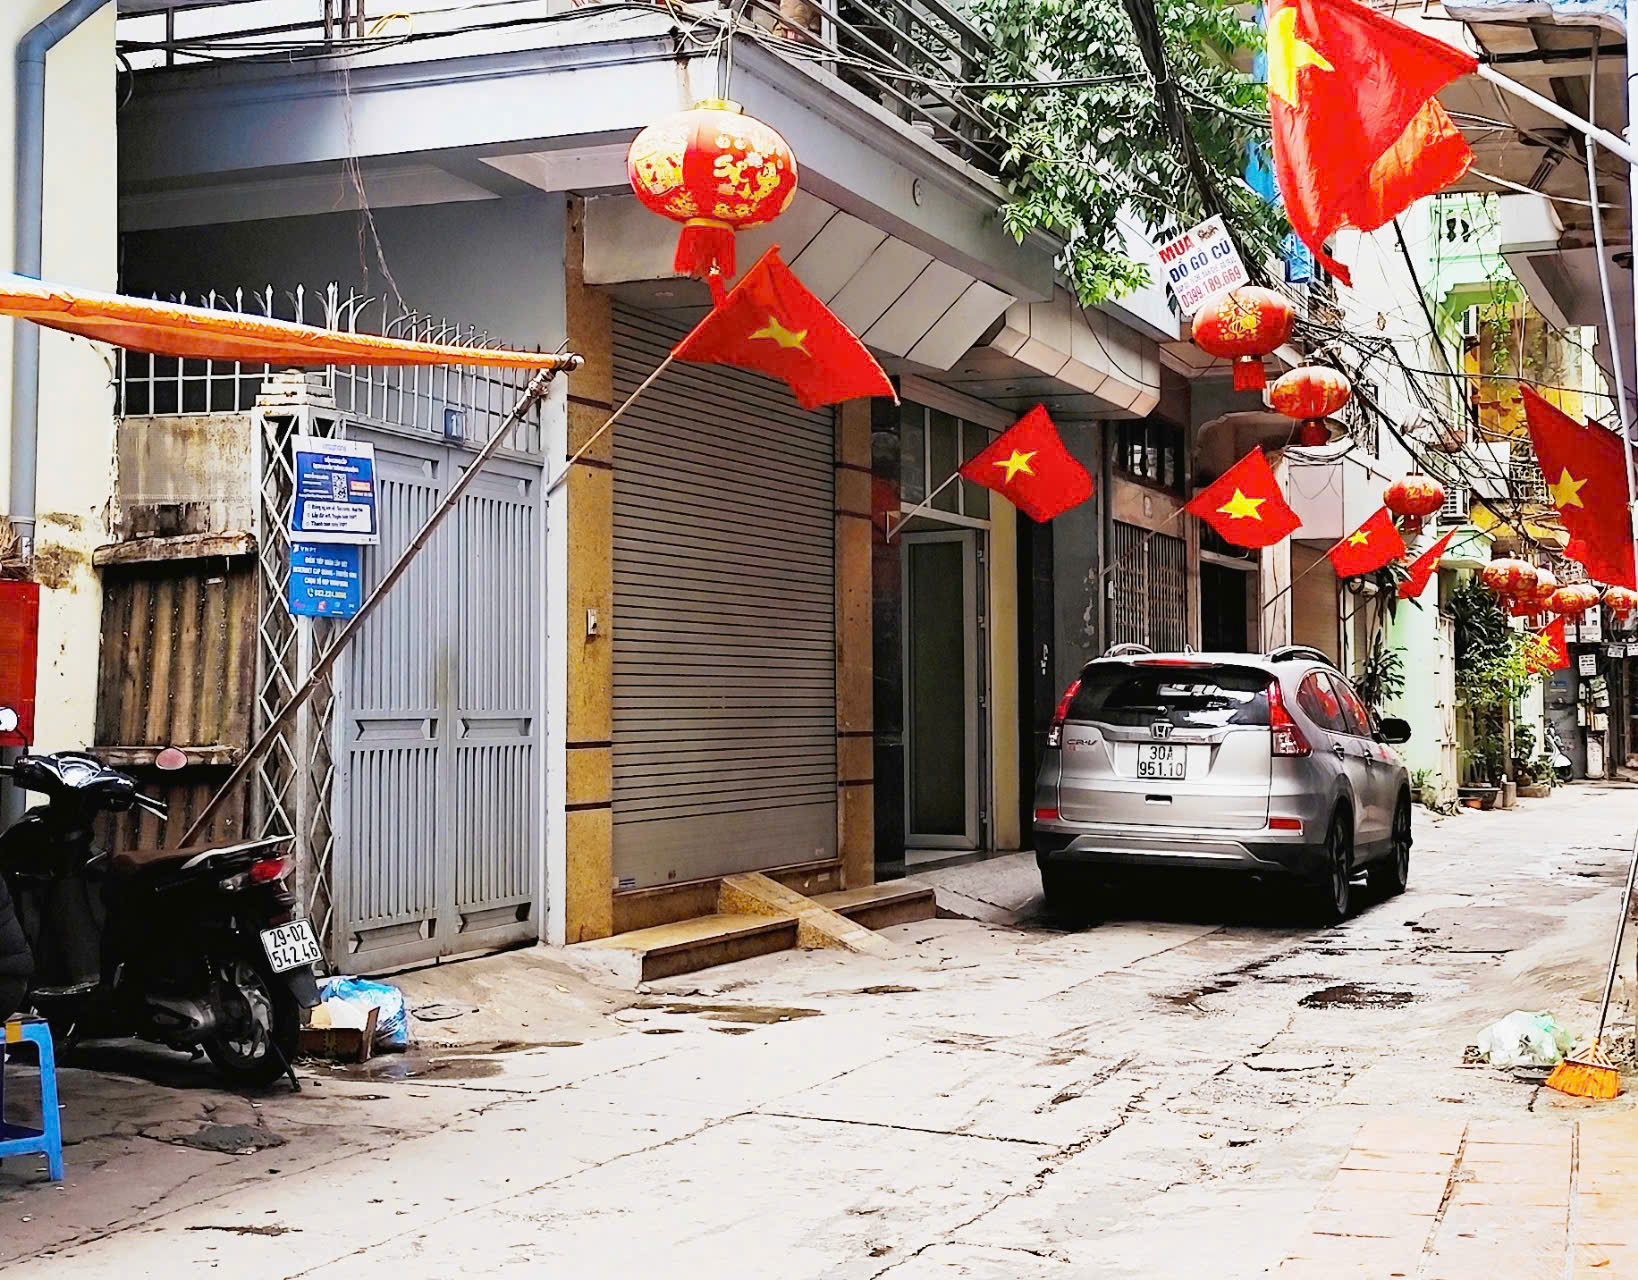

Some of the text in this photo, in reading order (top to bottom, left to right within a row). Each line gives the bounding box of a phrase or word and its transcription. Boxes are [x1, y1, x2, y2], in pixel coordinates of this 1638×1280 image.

[1159, 235, 1195, 264] MUA
[1150, 746, 1173, 761] 30A
[1139, 762, 1183, 777] 951.10
[272, 941, 318, 968] 542.46
